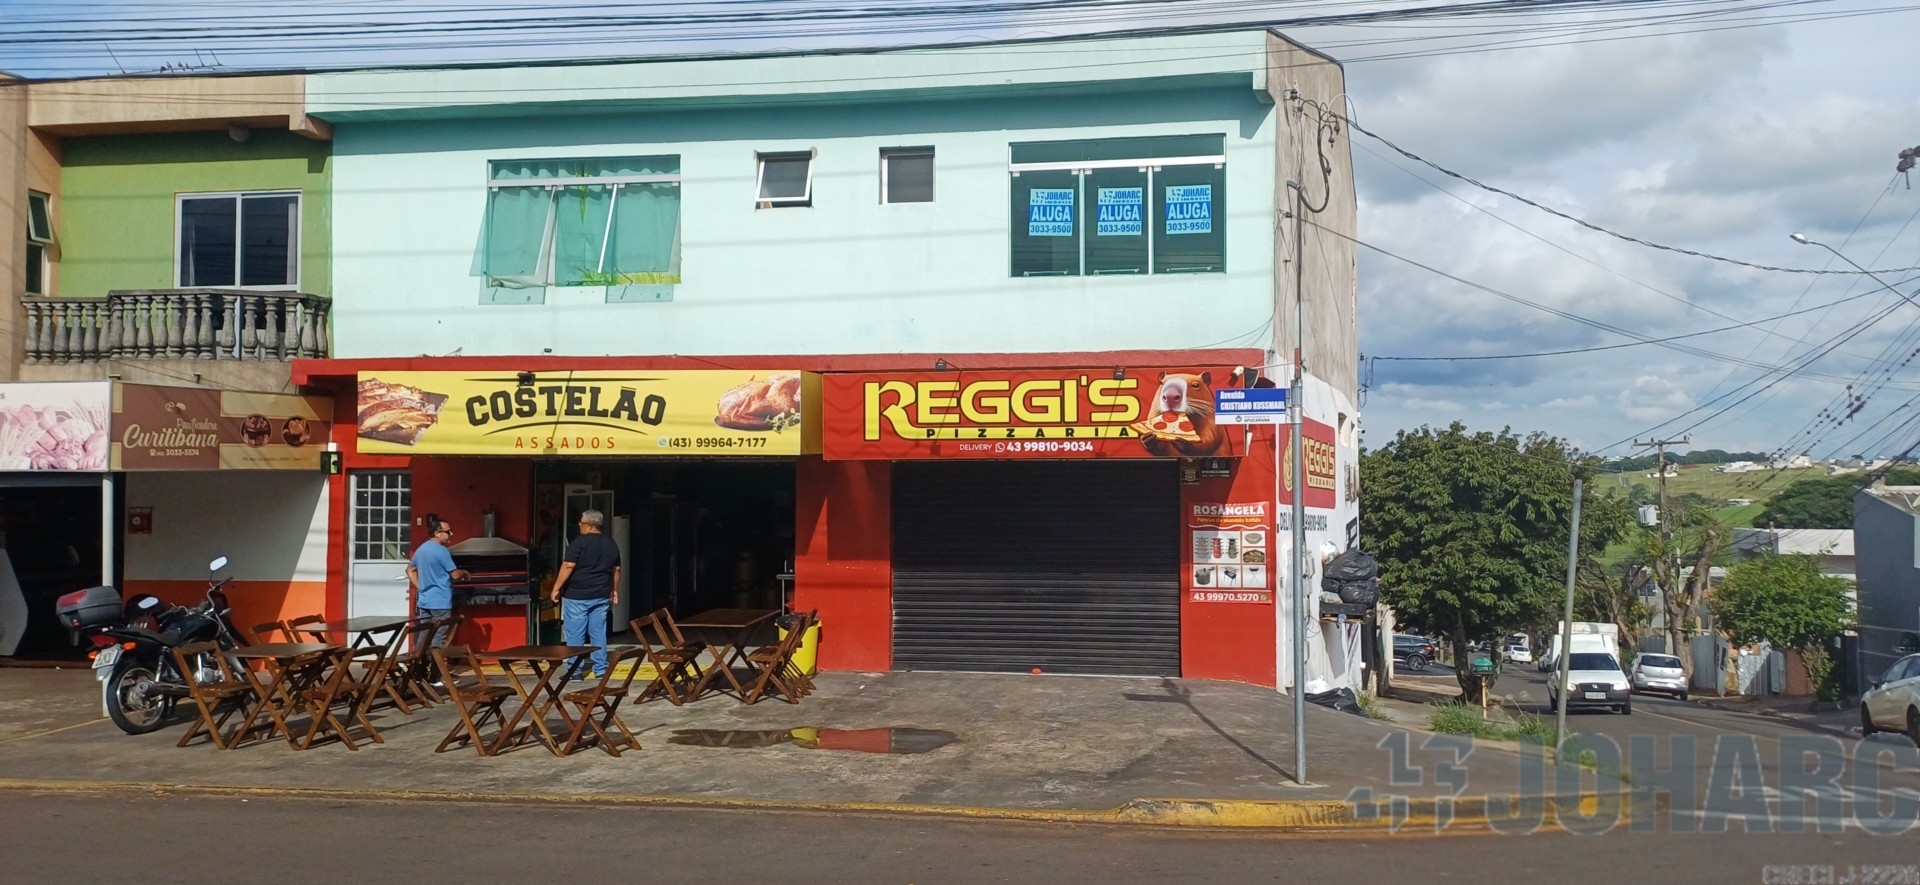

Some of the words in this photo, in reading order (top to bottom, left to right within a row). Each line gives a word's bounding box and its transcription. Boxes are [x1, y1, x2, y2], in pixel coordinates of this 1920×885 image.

[1045, 192, 1072, 200] JOHARC
[1113, 191, 1141, 199] JOHARC
[1181, 188, 1210, 197] JOHARC
[1031, 206, 1071, 222] ALUGA
[1099, 205, 1140, 221] ALUGA
[1167, 202, 1209, 219] ALUGA
[1030, 225, 1072, 233] 3033-9500
[1098, 224, 1141, 232] 3033-9500
[1167, 222, 1210, 231] 3033-9500
[1220, 391, 1245, 399] Avenida
[465, 385, 667, 427] COSTELÃO
[864, 375, 1141, 441] REGGI'S
[1220, 402, 1252, 410] CRISTIANO
[123, 423, 219, 449] Curitibana
[926, 427, 1130, 439] PIZZARIA
[515, 436, 615, 449] ASSADOS
[668, 437, 691, 448] (43)
[696, 437, 767, 448] 99964-7177
[959, 443, 992, 451] DELIVERY
[1006, 442, 1022, 452] 43
[1024, 441, 1094, 452] 99810-9034
[1193, 592, 1205, 601] 43
[1207, 592, 1259, 601] 99970.5270
